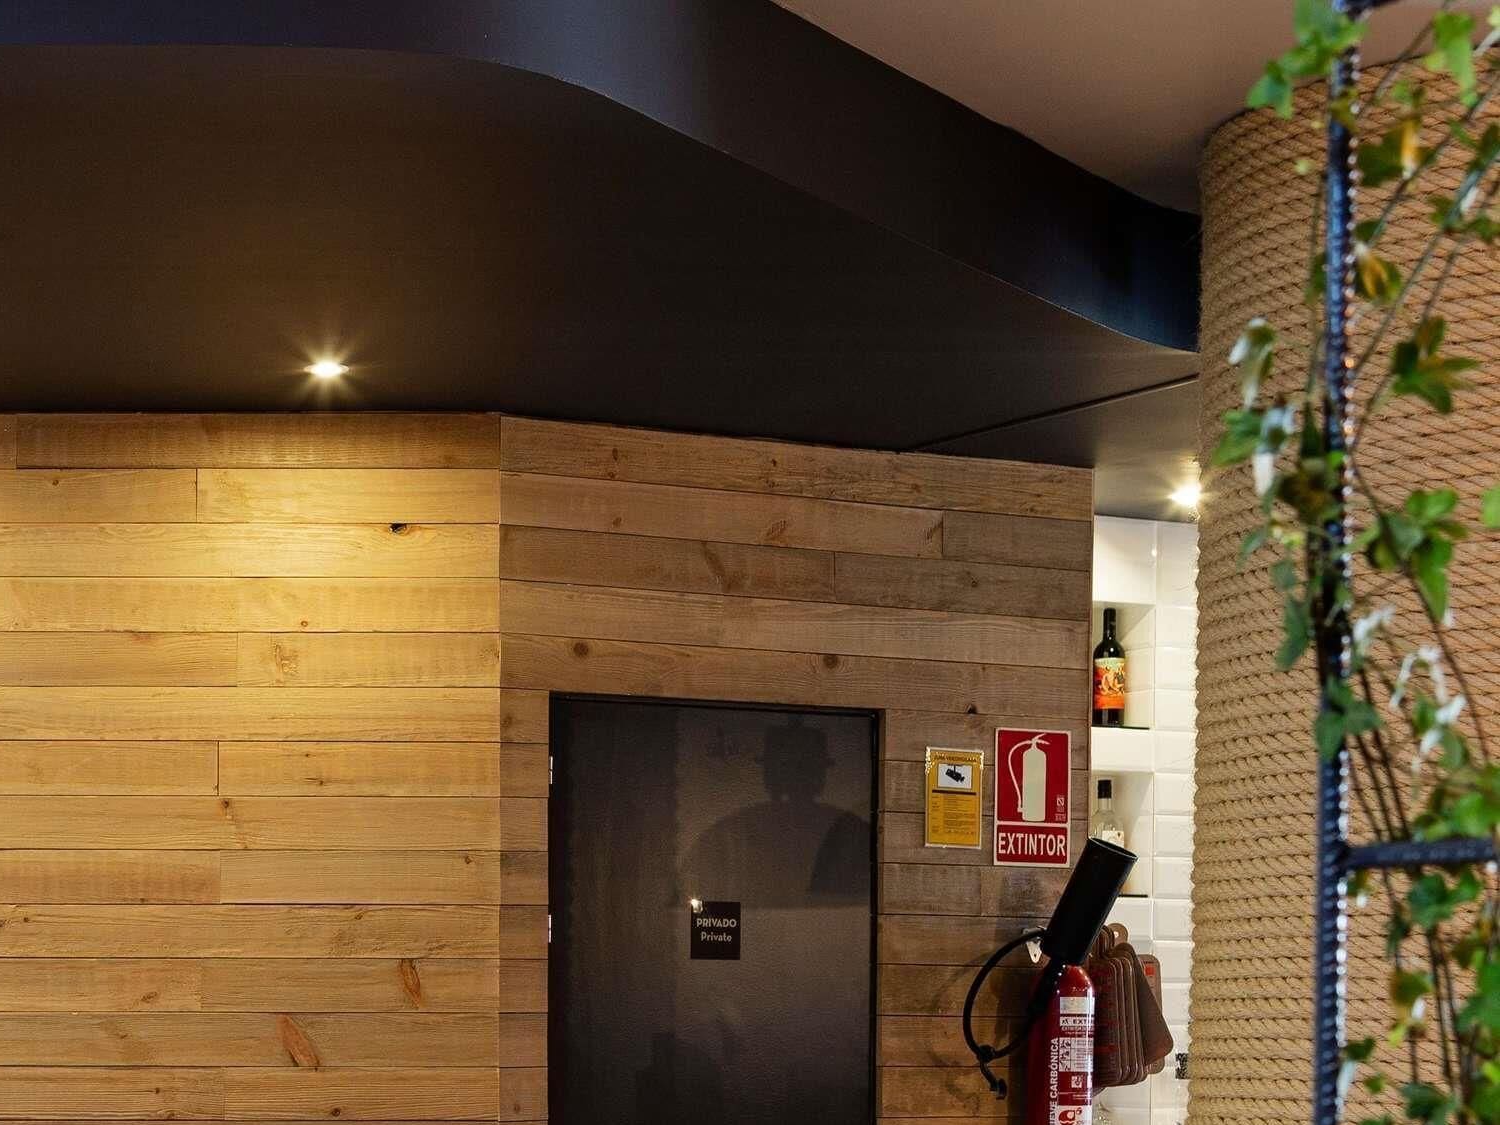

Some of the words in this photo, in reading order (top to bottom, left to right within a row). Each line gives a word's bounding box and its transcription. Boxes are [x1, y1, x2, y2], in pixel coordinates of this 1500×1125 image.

[998, 832, 1066, 857] EXTINTOR
[696, 918, 737, 928] PRIVADO
[700, 931, 733, 942] Private
[1049, 1037, 1059, 1098] CARBÓNICA
